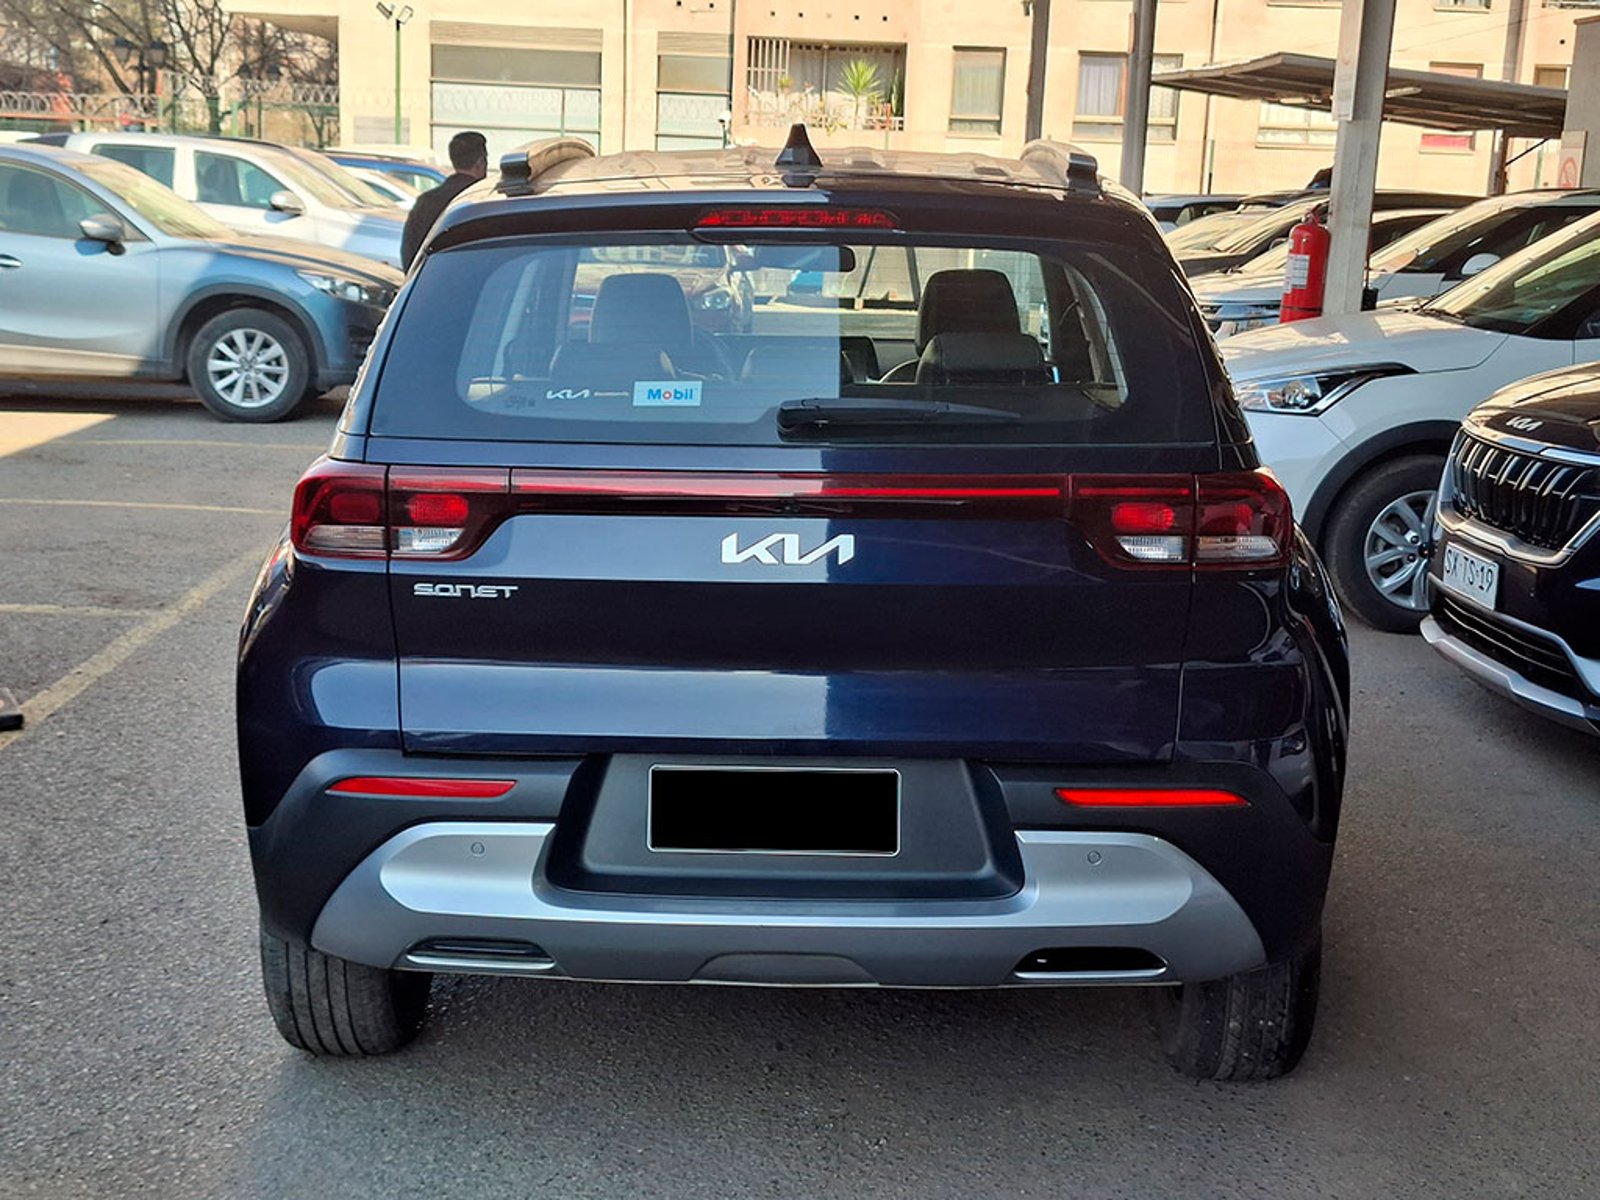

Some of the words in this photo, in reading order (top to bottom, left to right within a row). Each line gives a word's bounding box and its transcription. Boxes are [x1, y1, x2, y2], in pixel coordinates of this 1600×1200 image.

[647, 388, 693, 400] Mobil
[720, 531, 855, 565] KIA
[413, 583, 519, 599] SONET
